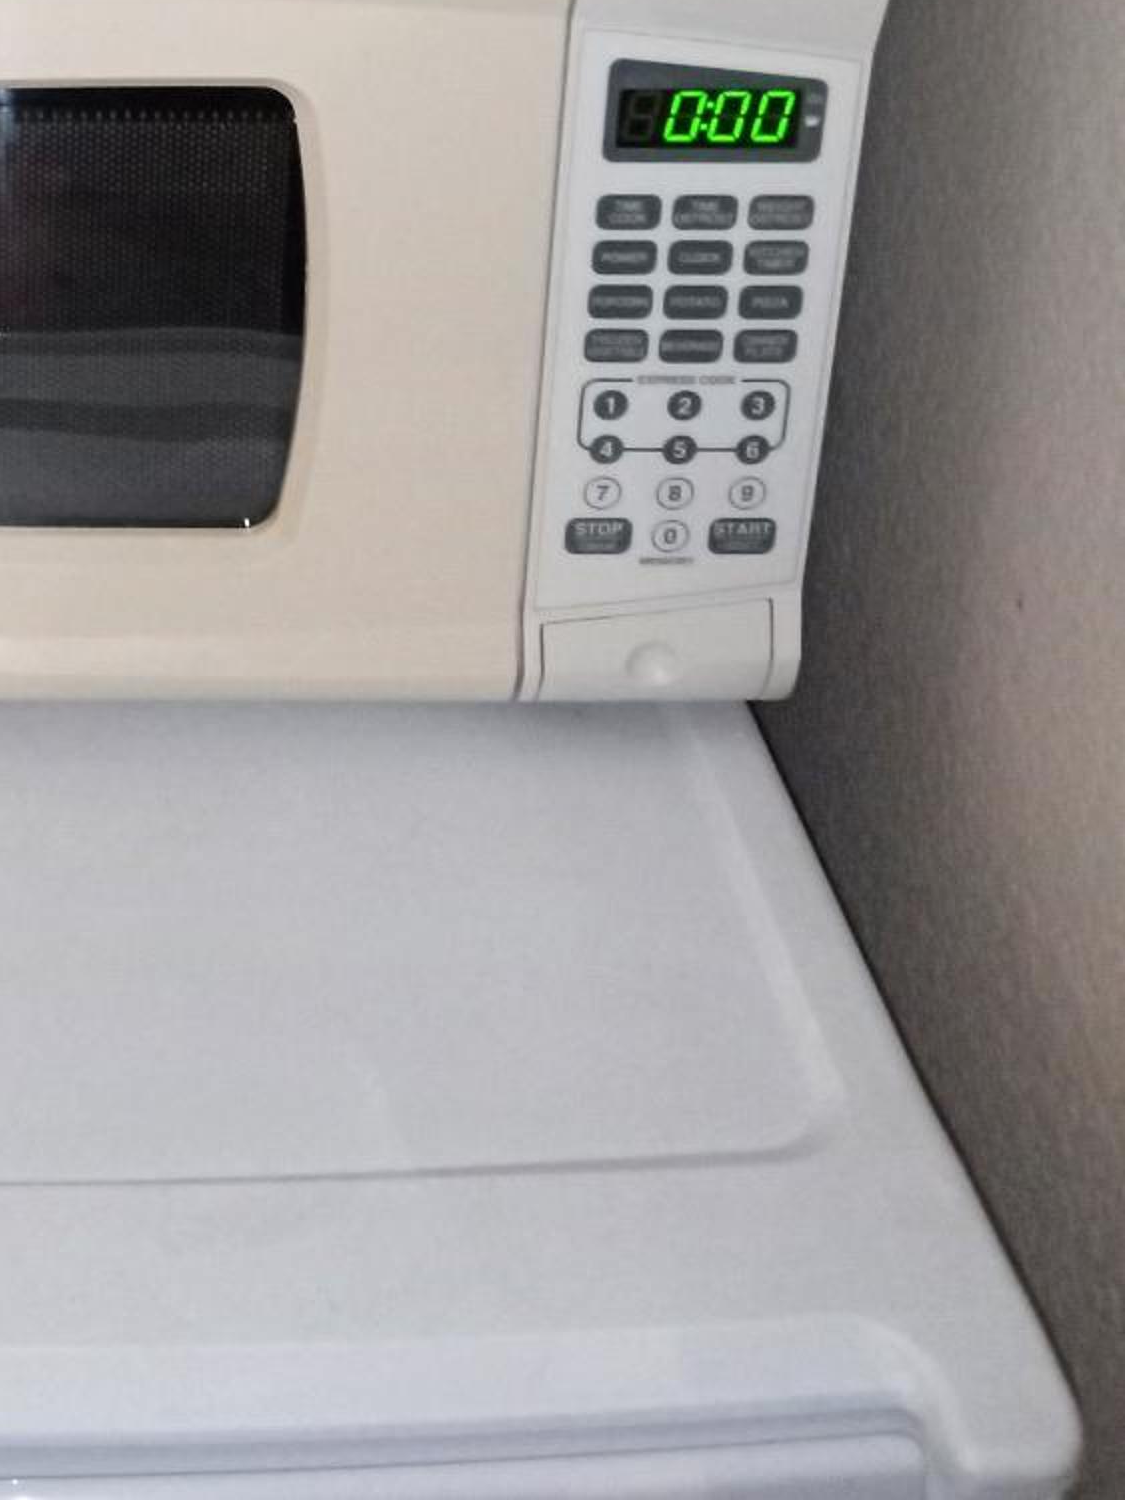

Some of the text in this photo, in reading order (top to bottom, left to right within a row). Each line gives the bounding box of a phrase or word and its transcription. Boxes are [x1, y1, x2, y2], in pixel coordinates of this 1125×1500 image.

[662, 90, 796, 143] 0:00
[606, 397, 616, 413] 1
[678, 398, 691, 414] 2
[751, 398, 764, 414] 3
[599, 442, 613, 457] 4
[673, 442, 686, 458] 5
[746, 442, 759, 458] 6
[596, 485, 609, 501] 7
[668, 485, 681, 501] 8
[740, 485, 754, 501] 9
[663, 529, 676, 544] 0
